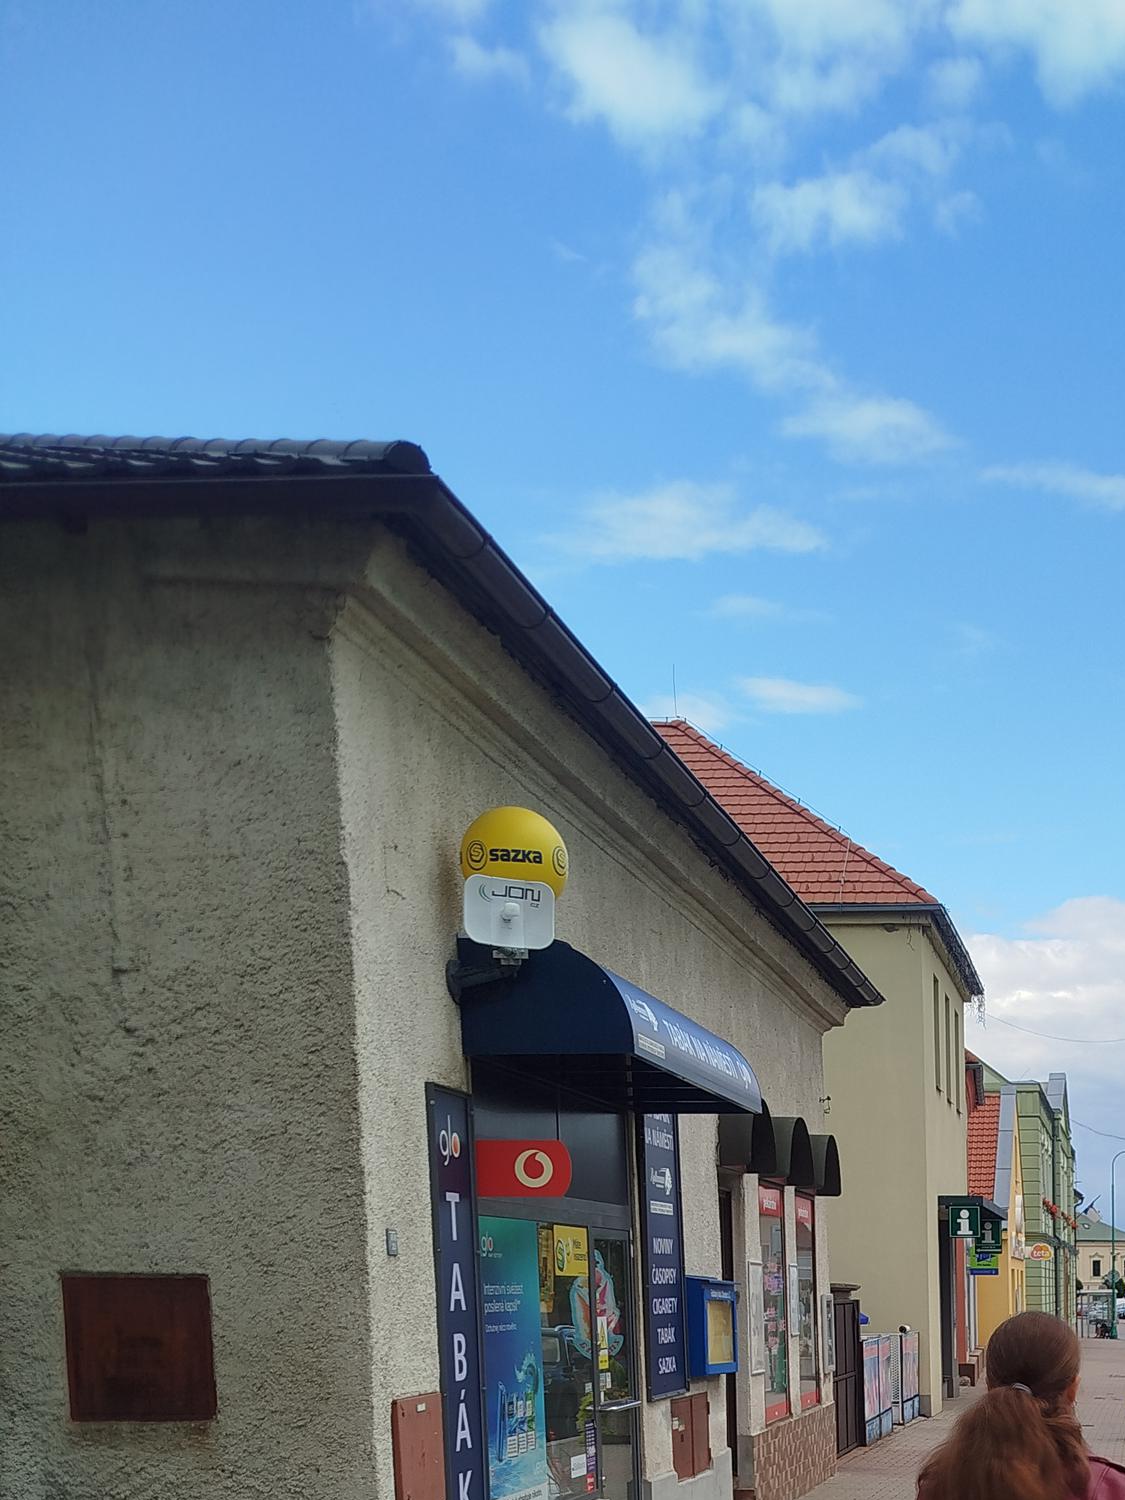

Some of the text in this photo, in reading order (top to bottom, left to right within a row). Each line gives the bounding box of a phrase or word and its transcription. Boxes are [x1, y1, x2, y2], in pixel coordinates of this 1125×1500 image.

[491, 885, 541, 902] JON
[439, 1114, 461, 1166] glo
[652, 1237, 674, 1255] NOVINY
[1033, 1249, 1050, 1258] teta
[652, 1264, 677, 1285] ČASOPISY
[652, 1298, 678, 1315] CIGARETY
[657, 1323, 676, 1345] TABÁK
[658, 1356, 678, 1375] SAZKA
